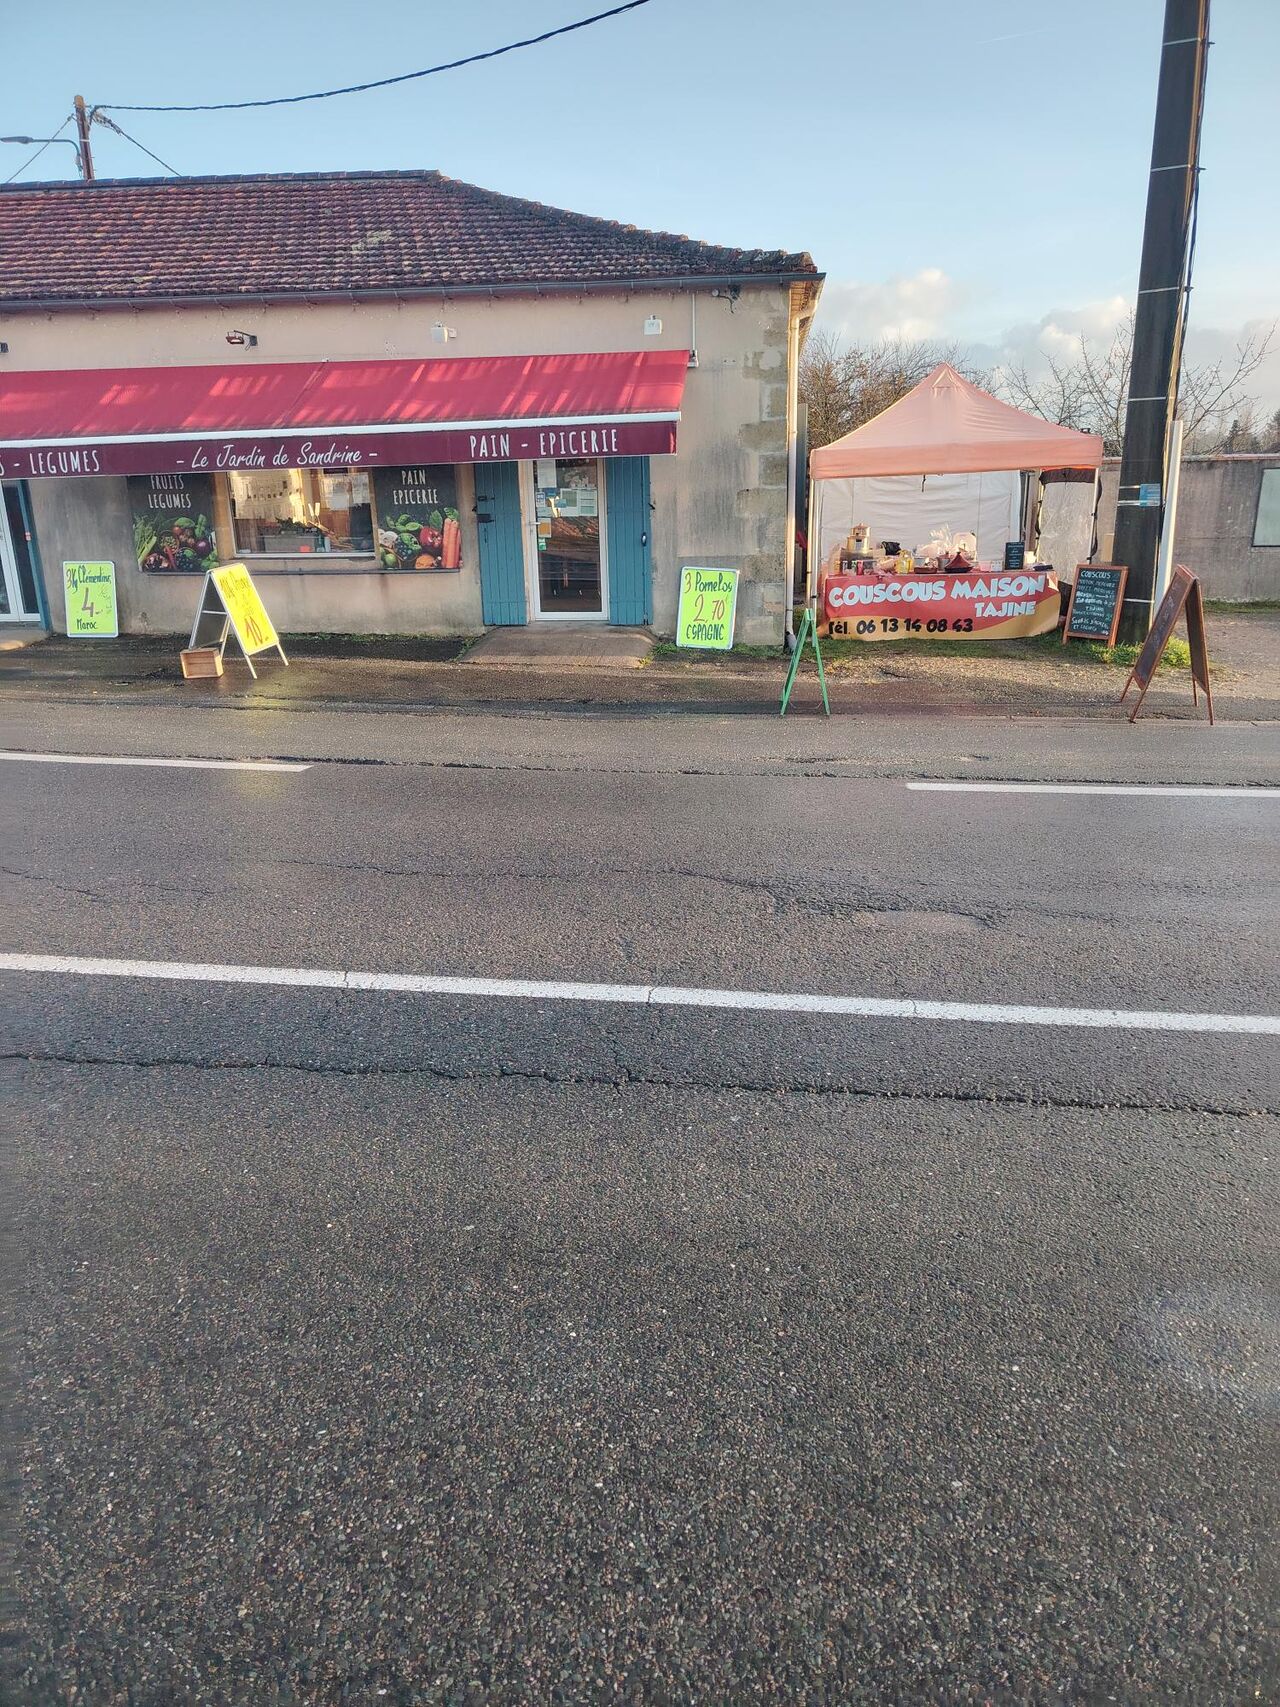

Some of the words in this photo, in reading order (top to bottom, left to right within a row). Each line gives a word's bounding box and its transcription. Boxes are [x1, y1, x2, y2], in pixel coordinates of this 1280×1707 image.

[470, 434, 510, 458] PAIN
[539, 429, 618, 456] EPICERIE
[29, 449, 100, 474] LEGUMES
[191, 446, 209, 468] Le
[216, 444, 266, 468] Jardin
[272, 444, 290, 466] de
[296, 441, 362, 465] Sandrine
[150, 474, 185, 490] FRUITS
[401, 469, 426, 485] PAIN
[147, 493, 192, 509] LEGUMES
[393, 488, 439, 505] EPICERIE
[684, 572, 692, 594] 3
[694, 571, 732, 592] Pomelos
[1080, 570, 1112, 579] COUSCOUS
[828, 580, 947, 608] COUSCOUS
[950, 575, 1046, 600] MAISON
[974, 600, 1037, 618] TAJINE
[856, 620, 877, 634] 06
[880, 618, 899, 632] 13
[904, 619, 922, 632] 14
[926, 619, 948, 633] 08
[952, 618, 973, 632] 43
